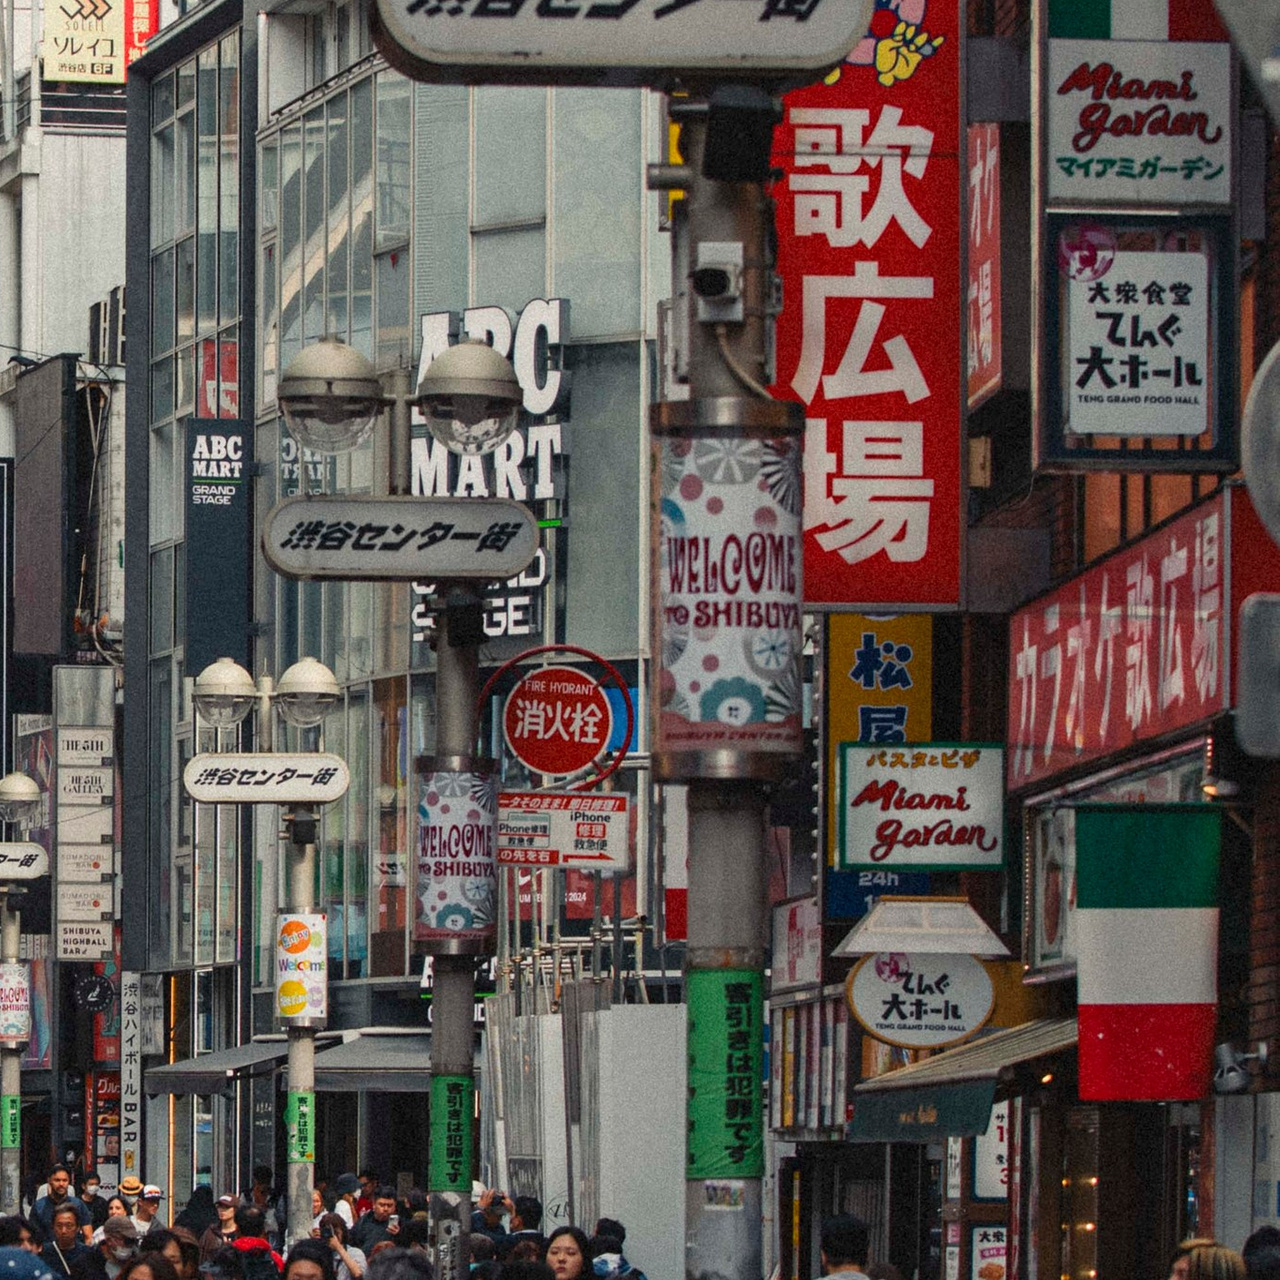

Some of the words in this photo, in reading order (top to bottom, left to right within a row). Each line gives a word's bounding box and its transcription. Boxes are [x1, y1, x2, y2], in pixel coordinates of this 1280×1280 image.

[65, 21, 105, 32] SOLEIL
[53, 37, 117, 58] ソレイユ
[1057, 61, 1199, 101] Miami
[1056, 156, 1225, 181] マイアミガーデン
[1088, 281, 1194, 306] 大衆食堂
[789, 104, 935, 565] 歌広場
[1095, 311, 1183, 348] てんぐ
[1075, 346, 1203, 390] 大ホール
[193, 435, 243, 460] ABC
[193, 461, 242, 478] MART
[192, 485, 236, 495] GRAND
[192, 495, 232, 505] STAGE
[280, 521, 524, 553] 渋谷センター街
[666, 536, 798, 595] WELCOME
[525, 680, 547, 693] FIRE
[550, 682, 596, 696] HYDRANT
[515, 699, 603, 744] 消火栓
[866, 749, 981, 769] パスタとピザ
[193, 767, 338, 787] 渋谷センター街
[850, 778, 970, 811] Miami
[570, 811, 612, 823] iPhone
[421, 824, 492, 859] WELCOME
[577, 823, 606, 838] 修理
[859, 872, 899, 887] 24h
[63, 927, 102, 936] SHIBUYA
[63, 937, 108, 946] HIGHBALL
[63, 947, 81, 956] BAR
[278, 958, 326, 973] Welcome
[881, 993, 962, 1021] 大ホール
[123, 983, 139, 1097] 渋谷ハイボール
[724, 981, 754, 1164] 客引きは犯罪です
[123, 1103, 137, 1143] BAR
